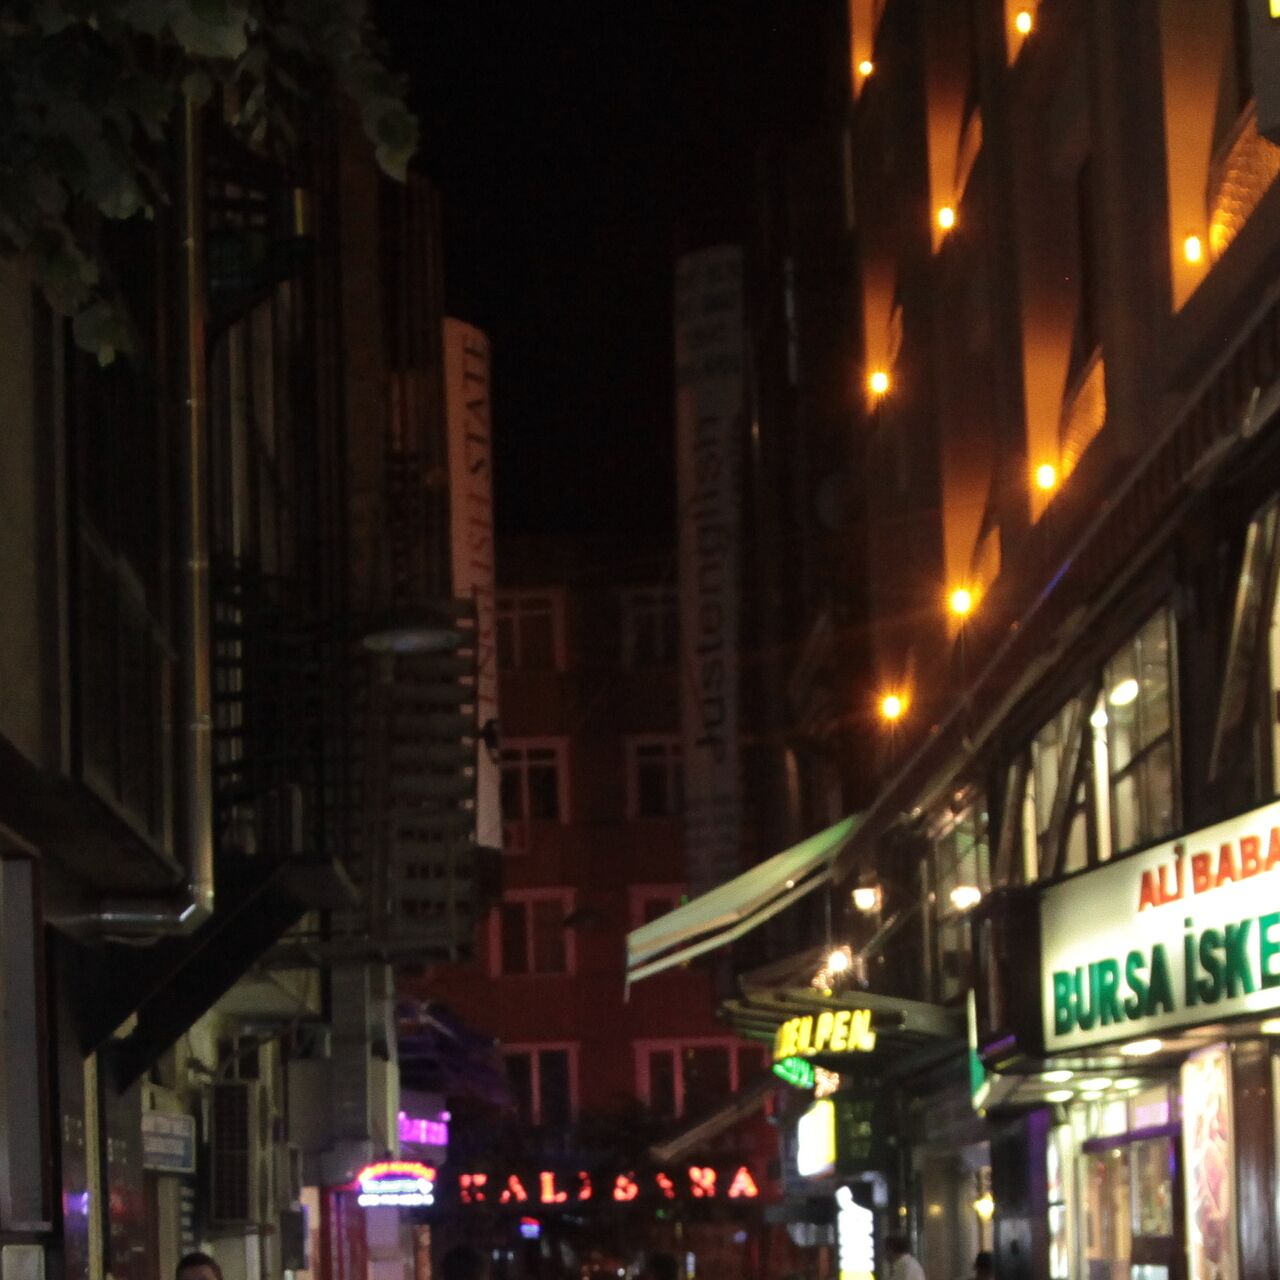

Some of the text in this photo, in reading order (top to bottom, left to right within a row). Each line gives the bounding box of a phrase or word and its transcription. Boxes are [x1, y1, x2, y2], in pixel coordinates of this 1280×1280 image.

[463, 336, 490, 476] STATE
[1138, 840, 1186, 912] ALİ
[1053, 942, 1175, 1036] BURSA
